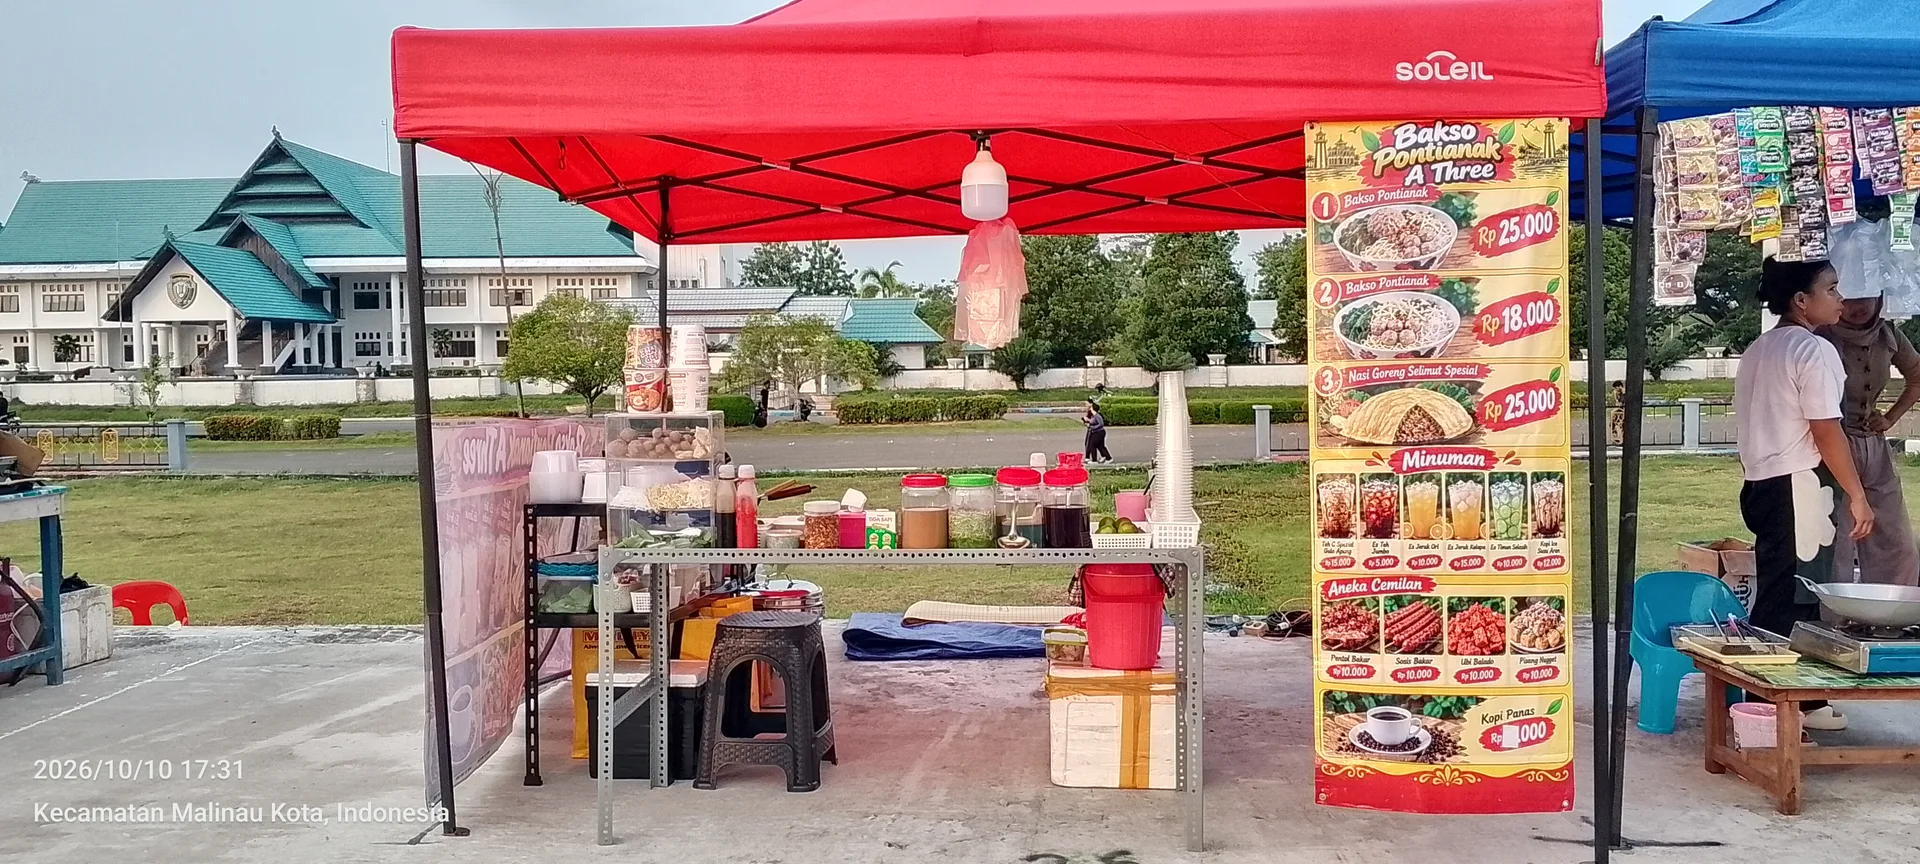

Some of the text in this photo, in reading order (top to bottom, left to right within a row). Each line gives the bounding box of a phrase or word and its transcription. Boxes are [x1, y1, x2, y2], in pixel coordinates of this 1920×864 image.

[1393, 121, 1477, 149] Bakso
[1372, 138, 1502, 177] Pontianak
[1404, 161, 1495, 186] A Three
[1321, 185, 1429, 217] 1 Bakso Pontianak
[1478, 210, 1553, 249] Rp 25.000
[1320, 274, 1430, 304] 2 Bakso Pontianak
[1481, 298, 1554, 336] Rp 18.000
[1322, 363, 1479, 391] 3 Nasi Goreng Selimut Spesial
[1484, 387, 1556, 423] Rp 25.000
[1402, 450, 1486, 472] Minuman
[1331, 558, 1351, 567] 15.000
[1375, 558, 1394, 567] 5.000
[1411, 557, 1439, 567] Rp 10.000
[1460, 558, 1481, 567] 15.000
[1503, 558, 1523, 568] 10.000
[1543, 557, 1562, 567] 12.000
[1327, 576, 1423, 597] Aneka Cemilan
[1331, 654, 1371, 663] Pentol Bakar
[1395, 657, 1433, 665] Sosis Bakar
[1460, 658, 1495, 666] Ubi Balado
[1519, 655, 1557, 666] Pisang Nugget
[1332, 666, 1368, 677] Rp 10.000
[1396, 669, 1433, 680] Rp 10.000
[1461, 669, 1494, 681] Rp 10.000
[1522, 668, 1553, 681] Rp 10.000
[1481, 708, 1536, 725] Kopi Panas
[1490, 732, 1503, 745] Rp
